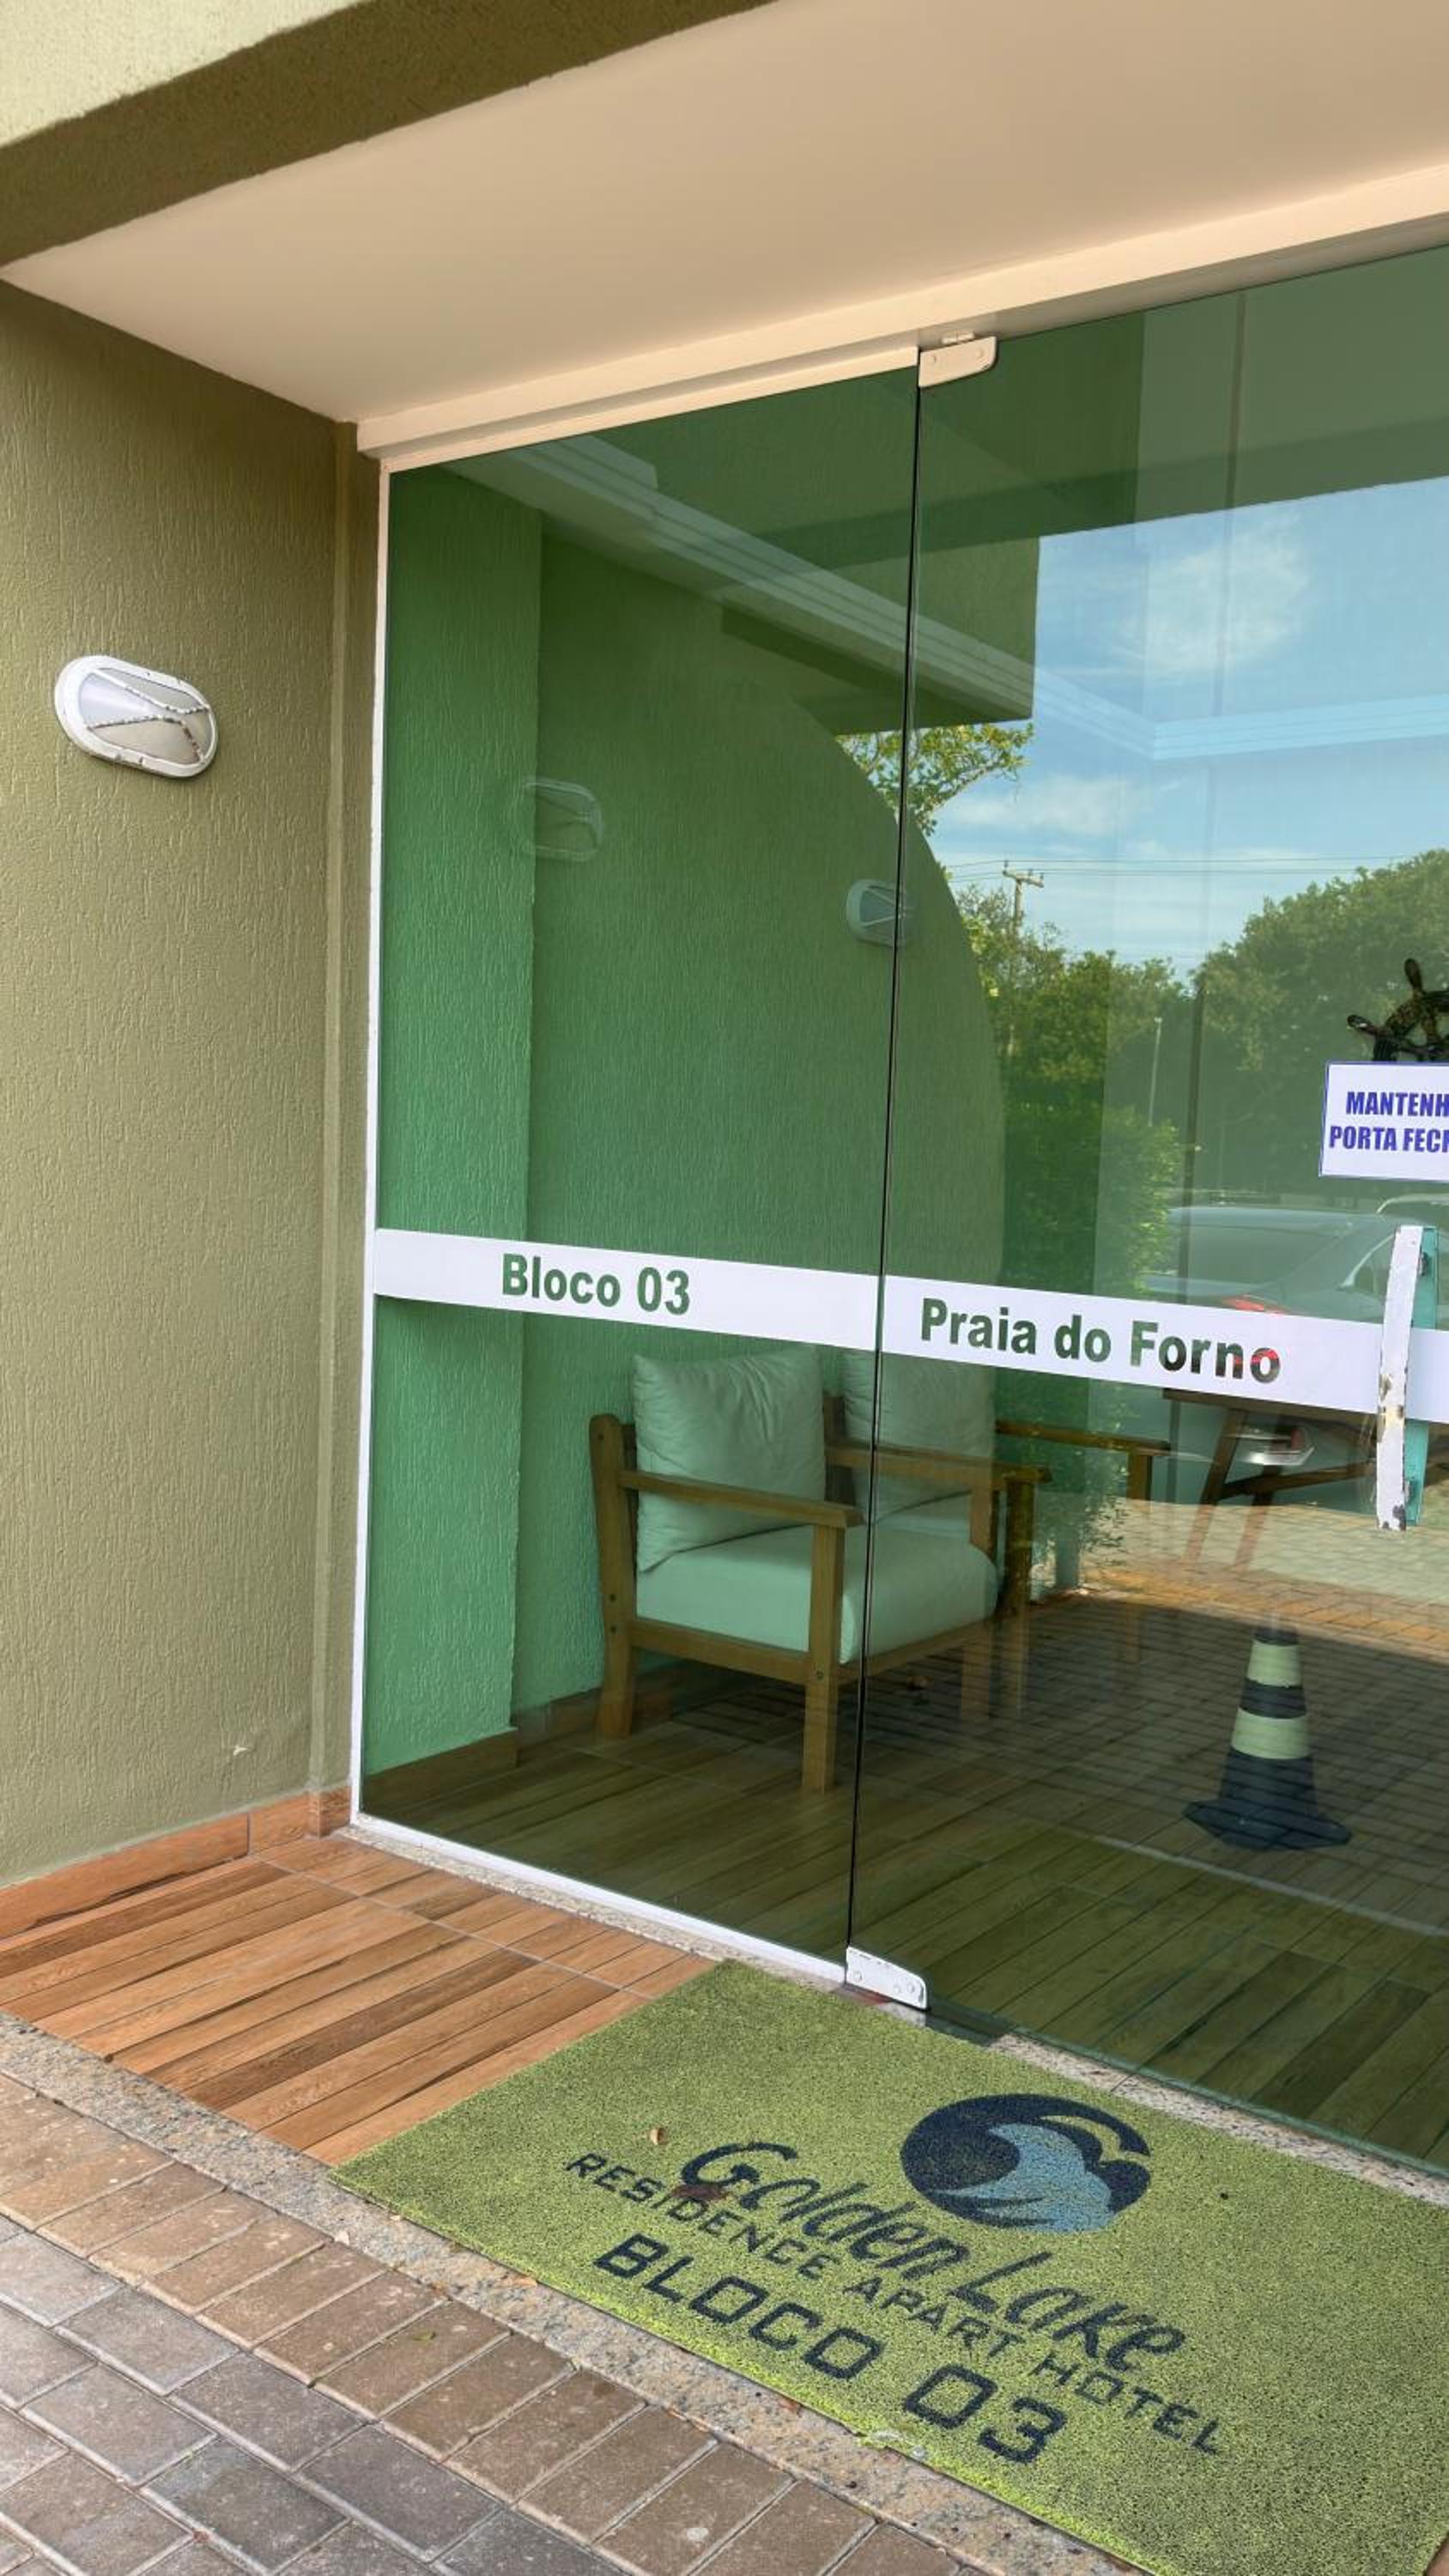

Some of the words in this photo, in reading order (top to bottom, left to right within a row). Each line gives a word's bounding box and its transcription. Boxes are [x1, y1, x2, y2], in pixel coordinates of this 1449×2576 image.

[1329, 1126, 1397, 1151] PORTA
[502, 1253, 621, 1308] Bloco
[636, 1267, 690, 1315] 03
[920, 1297, 1037, 1355] Praia
[1054, 1315, 1112, 1363] do
[1130, 1320, 1282, 1383] Forno
[564, 2153, 841, 2281] RESIDENCE
[842, 2276, 1027, 2358] APART
[1030, 2350, 1221, 2456] HOTEL
[681, 2142, 970, 2281] Golden
[948, 2251, 1185, 2372] Lake
[592, 2233, 886, 2380] BLOCO
[901, 2363, 1068, 2464] 03
